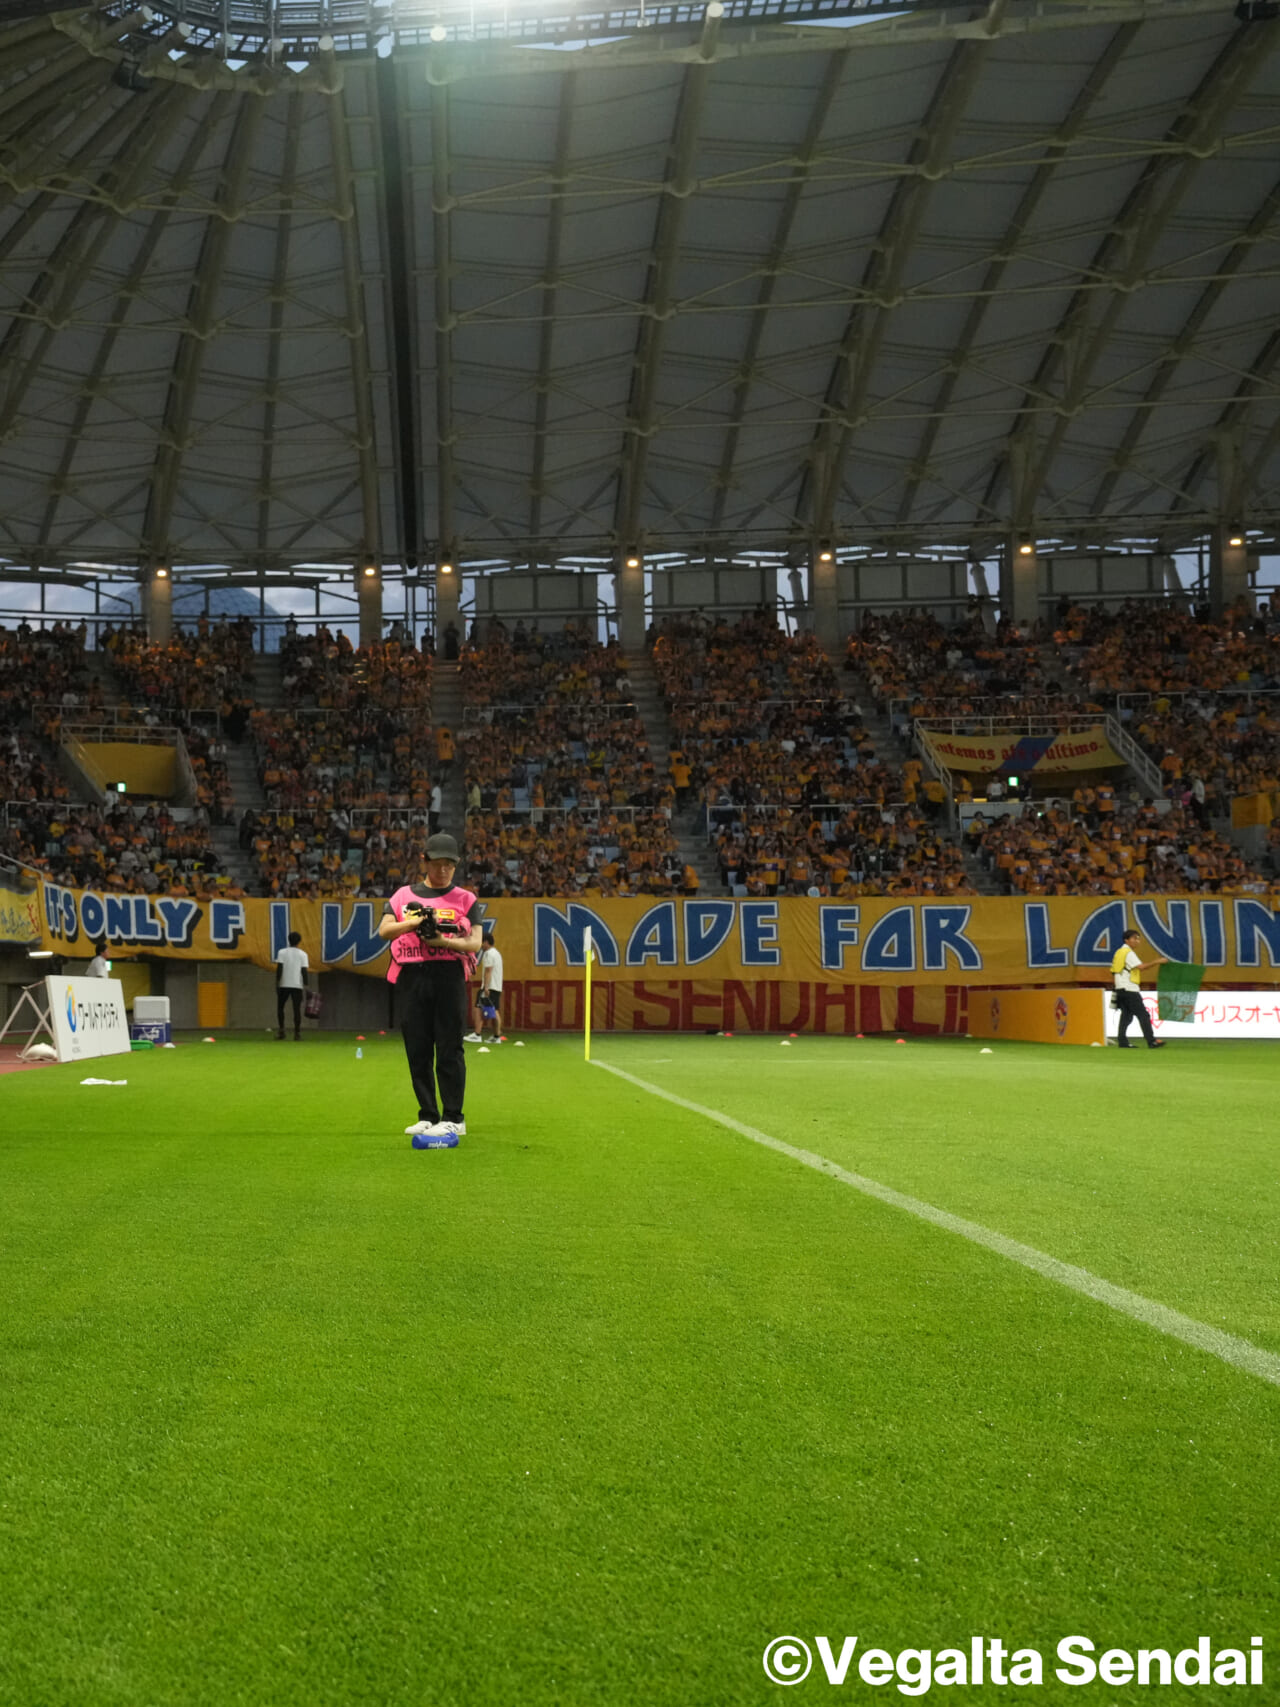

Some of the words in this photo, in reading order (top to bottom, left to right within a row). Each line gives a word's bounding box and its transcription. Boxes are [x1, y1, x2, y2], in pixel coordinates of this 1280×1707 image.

[44, 882, 78, 940] IT'S
[80, 891, 199, 943] ONLY
[534, 900, 780, 967] MADE
